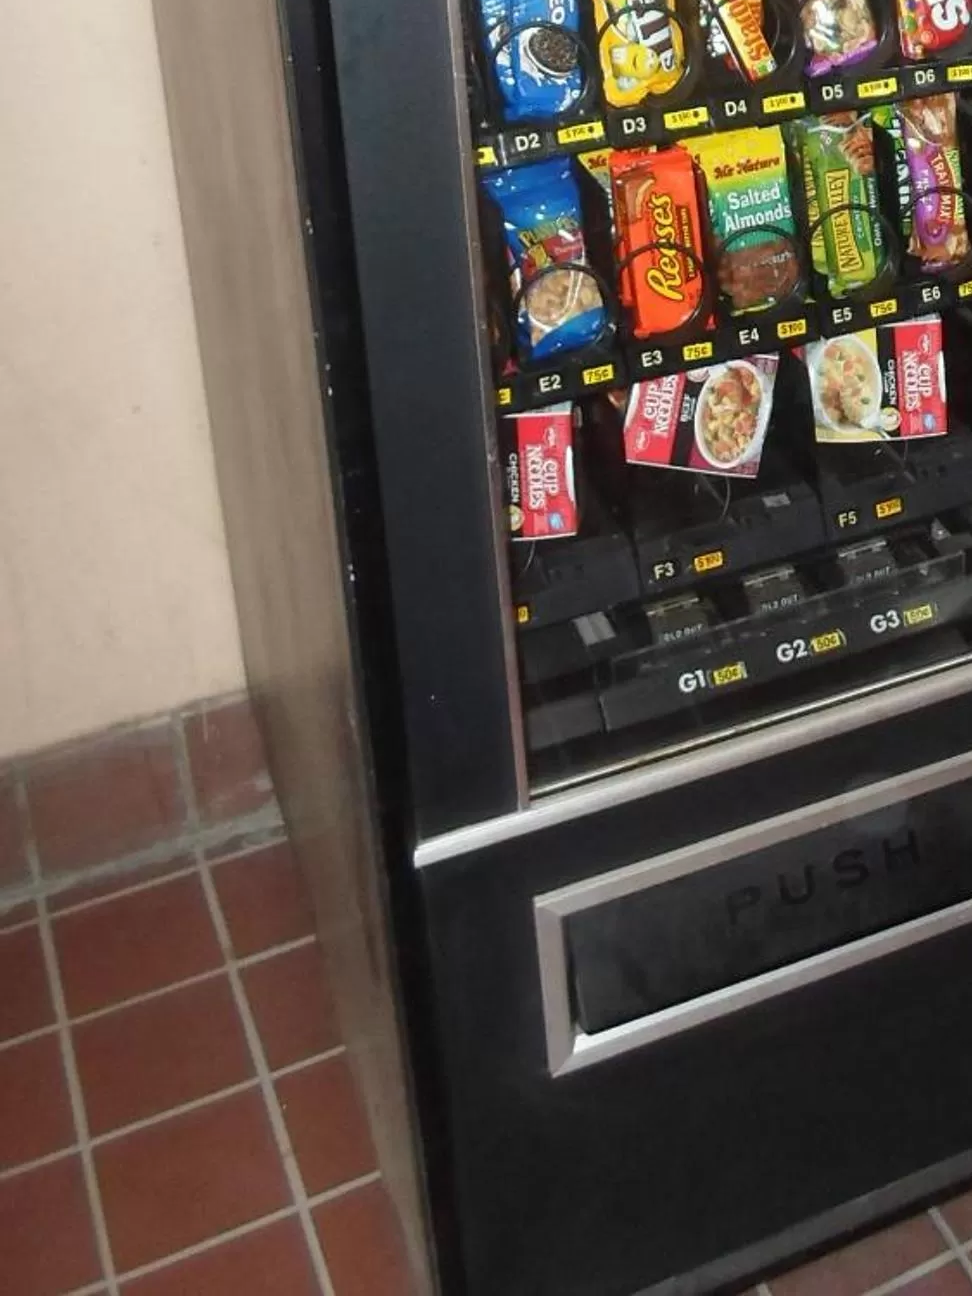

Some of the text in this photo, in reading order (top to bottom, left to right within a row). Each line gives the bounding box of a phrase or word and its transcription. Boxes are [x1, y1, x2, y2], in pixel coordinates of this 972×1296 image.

[914, 68, 936, 86] D6
[821, 83, 844, 101] D5
[724, 99, 748, 117] D4
[622, 117, 647, 135] D3
[514, 132, 542, 152] D2
[929, 154, 950, 191] TRAI
[726, 182, 782, 211] Salted
[724, 203, 793, 234] Almonds
[828, 173, 862, 272] NATURE VLLEY
[921, 286, 942, 302] E6
[832, 307, 853, 324] E5
[739, 328, 760, 345] E4
[641, 349, 663, 368] E3
[539, 375, 562, 393] E2
[887, 359, 897, 405] CHICKEN
[508, 452, 520, 503] CHICKEN
[838, 510, 858, 529] F5
[653, 562, 676, 581] F3
[870, 609, 900, 633] G3
[776, 638, 808, 663] G2
[678, 669, 706, 693] G1
[726, 828, 921, 927] PUSH
